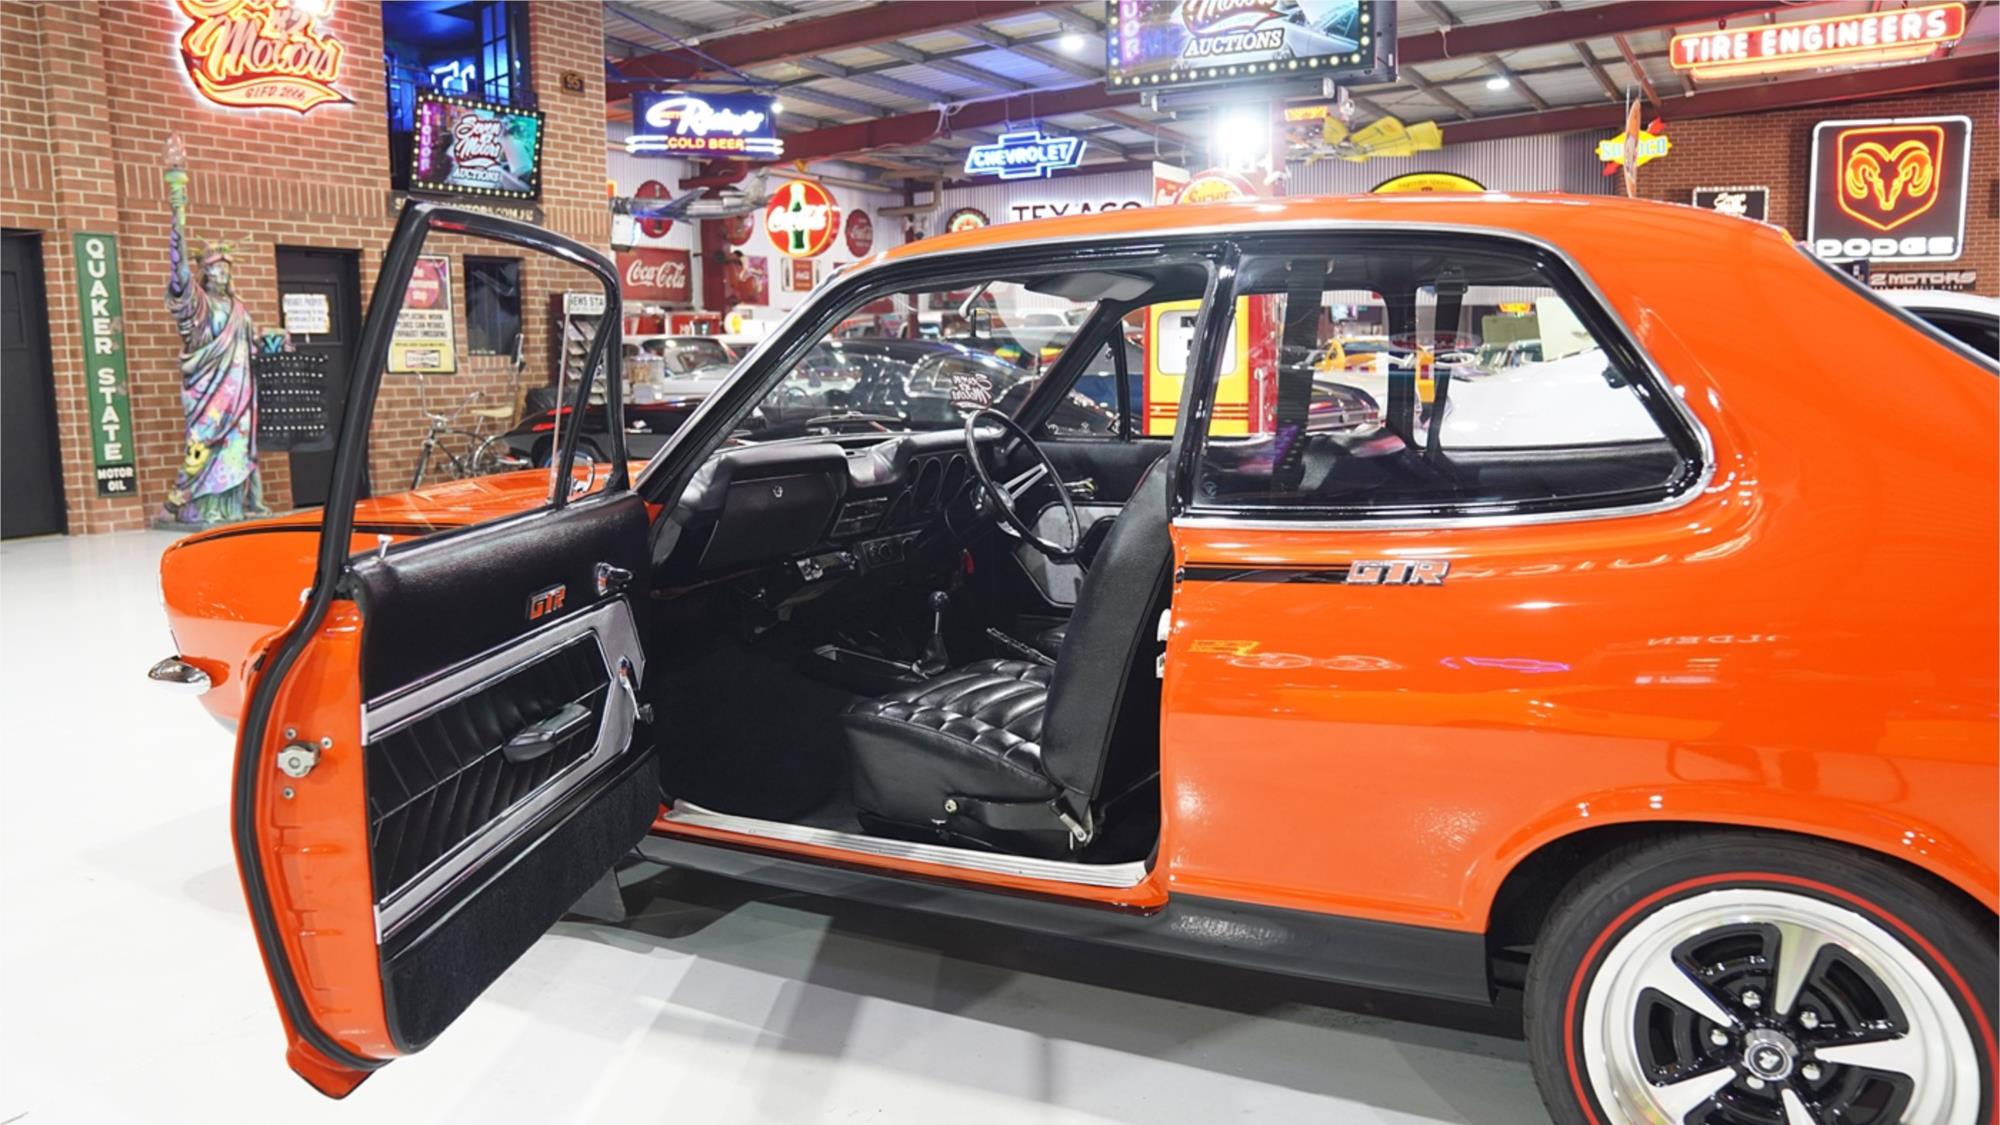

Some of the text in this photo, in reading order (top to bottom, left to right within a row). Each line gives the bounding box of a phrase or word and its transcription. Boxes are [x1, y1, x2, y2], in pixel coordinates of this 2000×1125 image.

[189, 15, 343, 81] Motors
[1185, 30, 1283, 57] AUCTIONS
[1680, 9, 1948, 63] TIRE ENGINEERS
[667, 137, 745, 151] COLD BEER
[974, 144, 1071, 168] CHEVROLET
[1602, 139, 1667, 160] SUOCO
[1815, 237, 1955, 257] DODGE
[626, 259, 686, 288] Coca-Cola
[1888, 271, 1977, 284] MOTORS
[85, 238, 123, 461] QUAKER STATE
[97, 466, 134, 480] MOTOR
[108, 480, 126, 492] OIL
[1344, 560, 1450, 585] GTR
[529, 584, 566, 620] GTR
